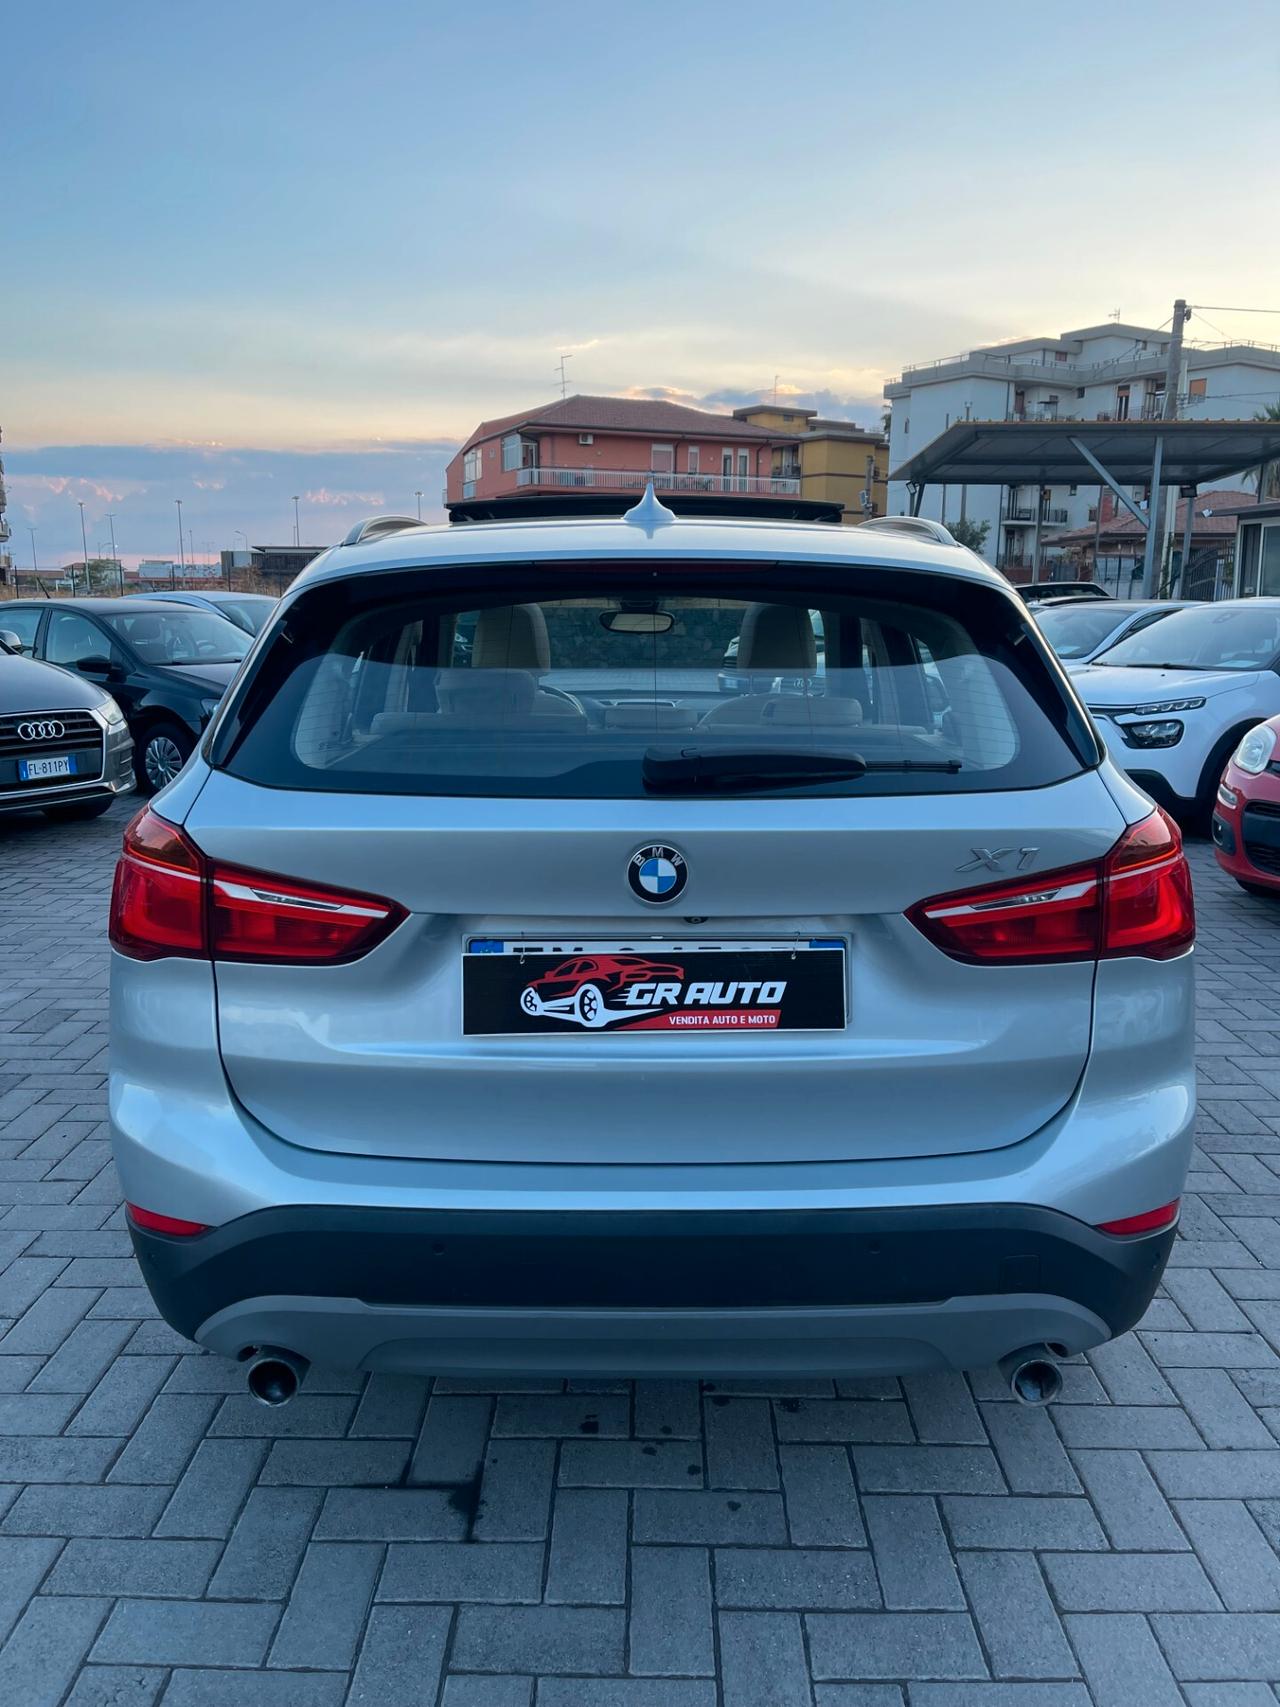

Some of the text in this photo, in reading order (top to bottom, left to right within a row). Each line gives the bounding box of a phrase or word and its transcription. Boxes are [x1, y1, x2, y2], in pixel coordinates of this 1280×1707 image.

[633, 847, 683, 867] BMW
[954, 847, 1040, 872] X1
[625, 981, 787, 1005] GR AUTO
[669, 1015, 776, 1025] VENDITA AUTO E MOTO
